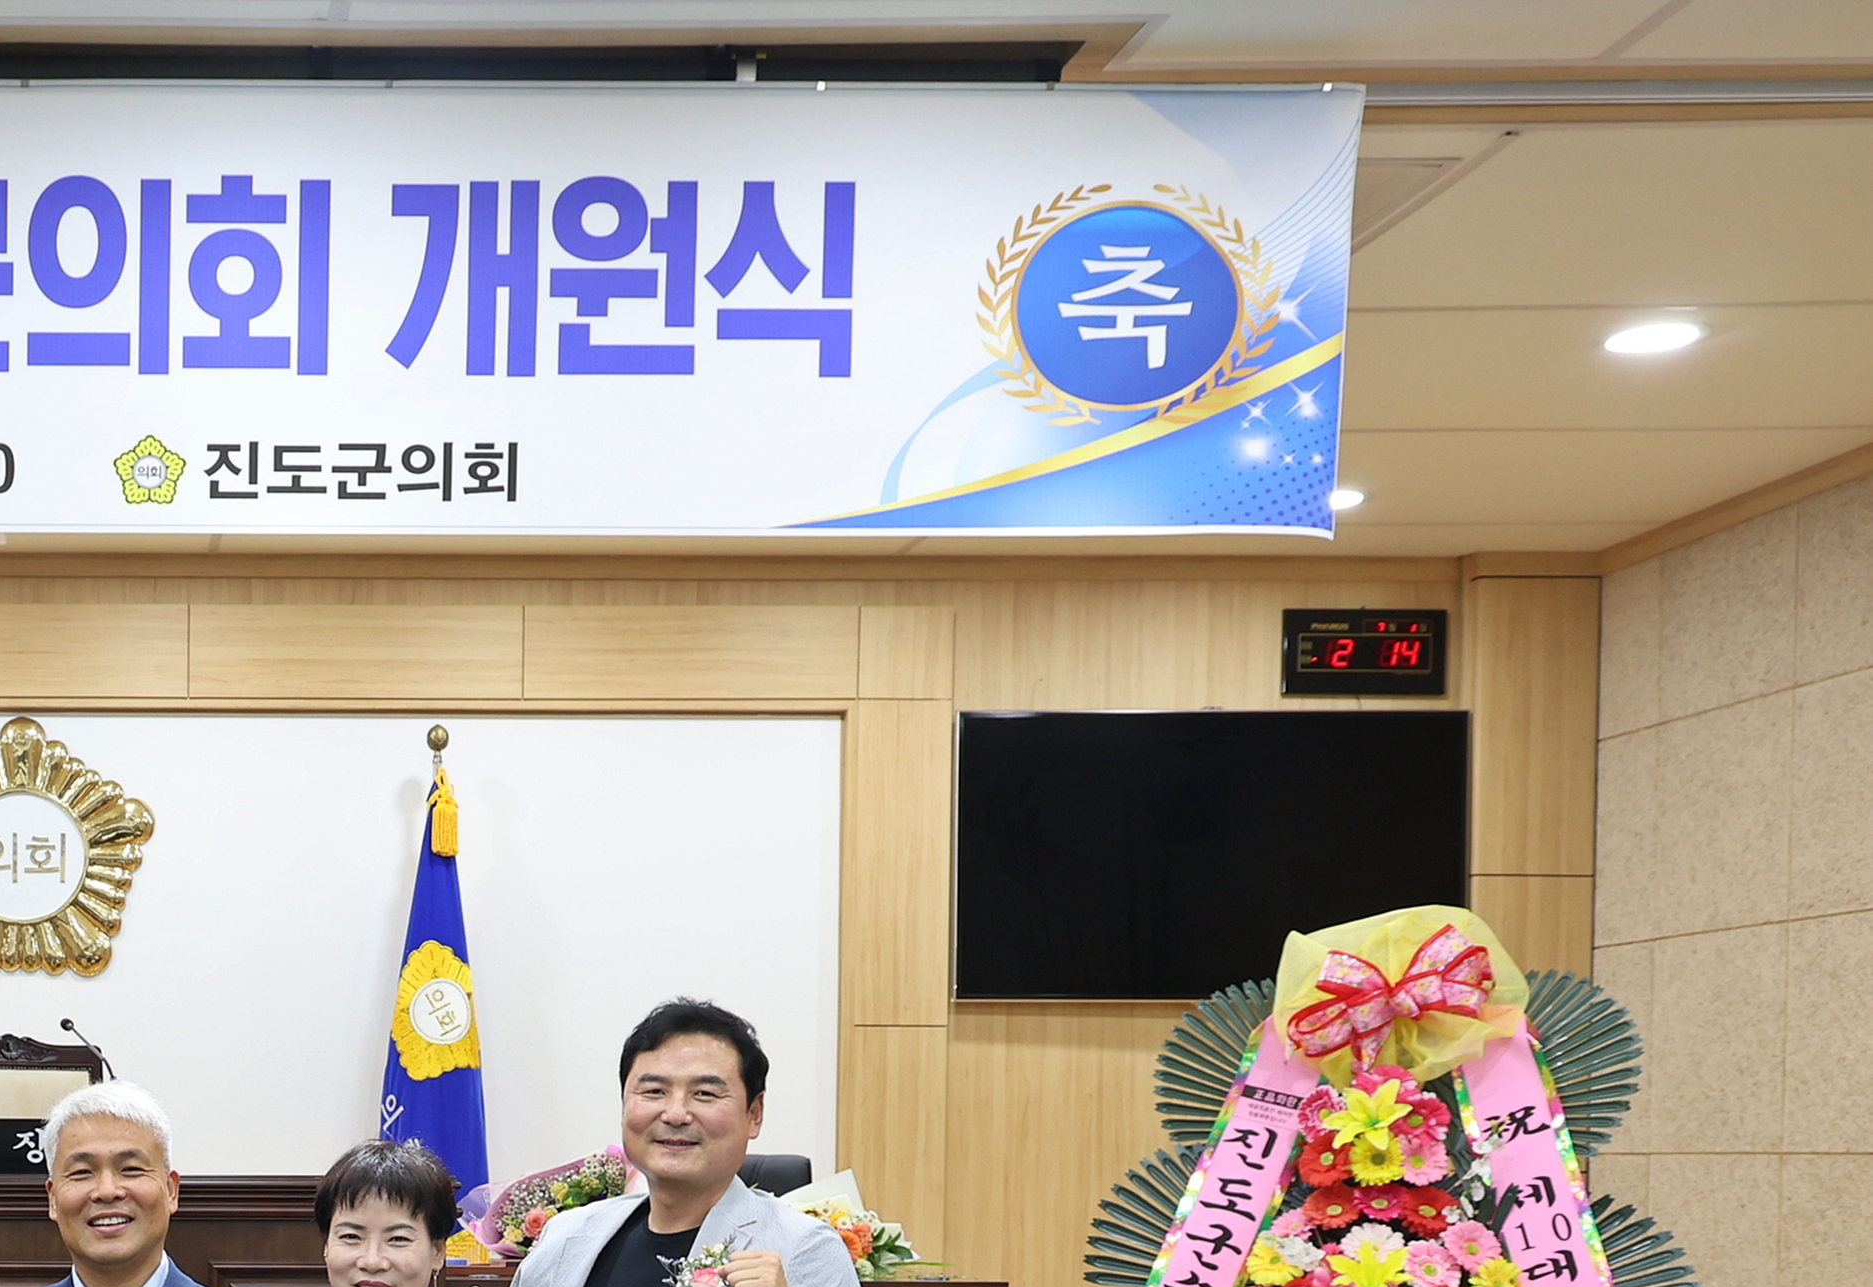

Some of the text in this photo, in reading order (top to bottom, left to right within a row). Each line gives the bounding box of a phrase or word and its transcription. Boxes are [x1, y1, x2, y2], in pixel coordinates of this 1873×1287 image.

[384, 175, 856, 378] 개원식
[1057, 243, 1193, 370] 축
[203, 440, 519, 503] 진도군의회
[1389, 641, 1421, 667] 14
[424, 988, 462, 1038] 의회
